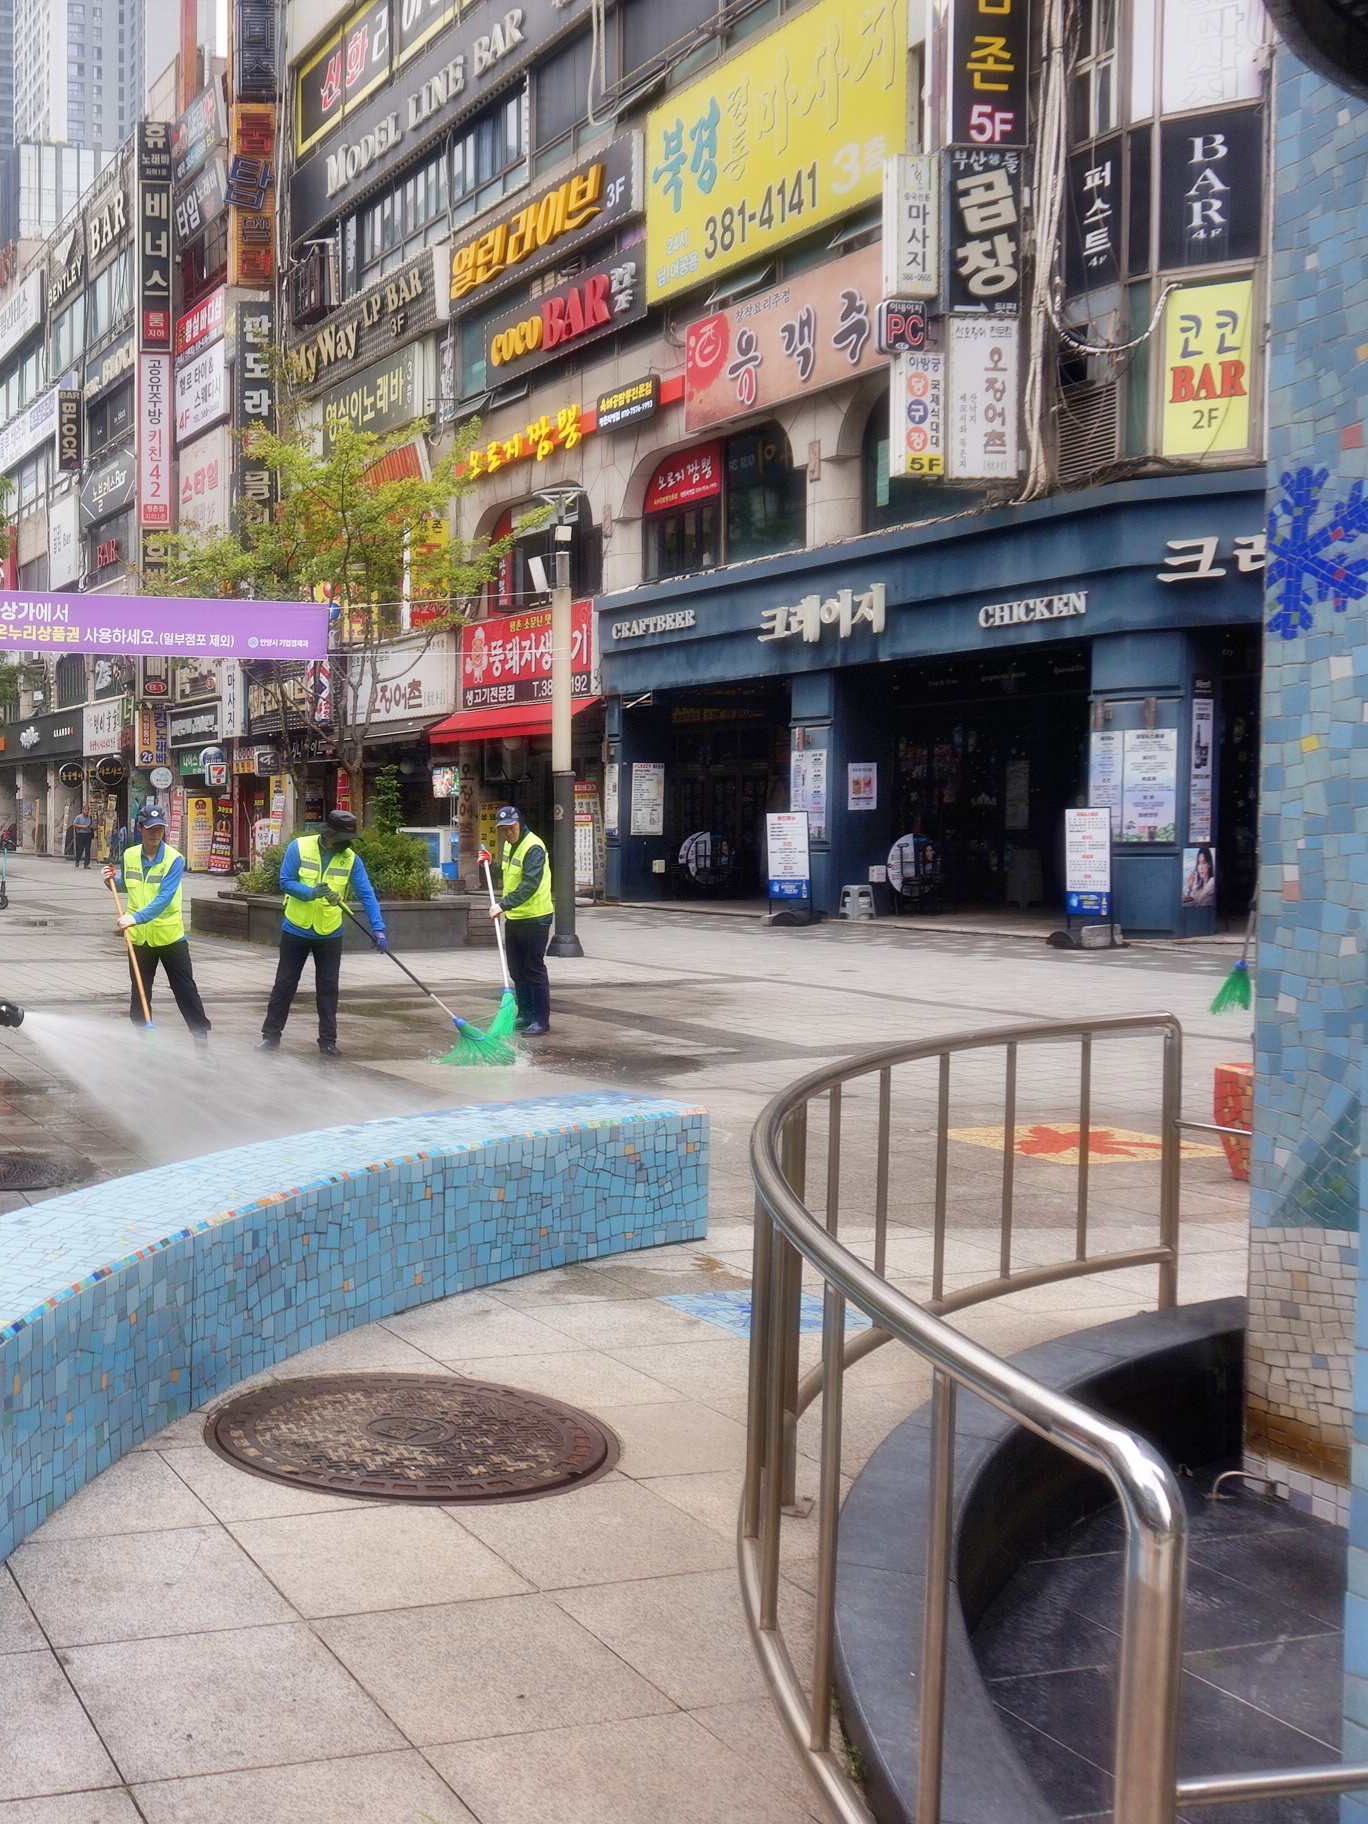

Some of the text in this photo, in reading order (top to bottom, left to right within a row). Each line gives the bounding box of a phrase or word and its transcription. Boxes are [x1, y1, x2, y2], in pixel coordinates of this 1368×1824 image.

[966, 0, 1015, 91] 존
[321, 23, 369, 112] 신화
[325, 112, 402, 198] MODEL
[407, 54, 468, 131] LINE
[473, 8, 526, 80] BAR
[145, 123, 166, 149] 휴
[206, 130, 216, 148] B2
[969, 104, 1014, 142] 5F
[832, 133, 887, 195] 3층
[1185, 133, 1231, 227] BAR
[606, 175, 625, 208] 3F
[704, 160, 819, 261] 381-4141
[1083, 160, 1112, 256] 퍼스트
[175, 190, 200, 238] 타임
[1191, 227, 1223, 240] 4F
[47, 190, 126, 308] BENTLEY BAR
[144, 192, 169, 296] 비너스
[666, 228, 689, 256] 24시
[906, 203, 931, 273] 마사지
[1088, 254, 1108, 268] 4F
[361, 266, 423, 328] LP BAR
[540, 274, 611, 352] BAR
[148, 313, 165, 327] 룸
[148, 329, 165, 337] 지하
[390, 313, 405, 337] 3F
[887, 314, 924, 346] PC
[909, 356, 942, 372] 아방궁
[1169, 359, 1248, 404] BAR
[60, 391, 80, 399] BAR
[909, 374, 926, 450] 당구장
[61, 402, 78, 460] BLOCK
[148, 359, 163, 498] 공유주방 키친42
[179, 408, 190, 430] 4F
[1191, 407, 1219, 430] 2F
[182, 459, 219, 504] 스타일
[909, 457, 941, 472] 5F
[96, 538, 120, 568] BAR
[523, 615, 543, 630] 소문난
[757, 582, 887, 645] 크레이지
[977, 590, 1090, 631] CHICKEN
[209, 633, 235, 649] 제외)
[259, 637, 279, 647] 안양시
[489, 623, 588, 678] 뚱돼지생기
[227, 673, 236, 729] 마사지
[466, 684, 516, 706] 생고기전문점
[141, 752, 153, 764] 2F
